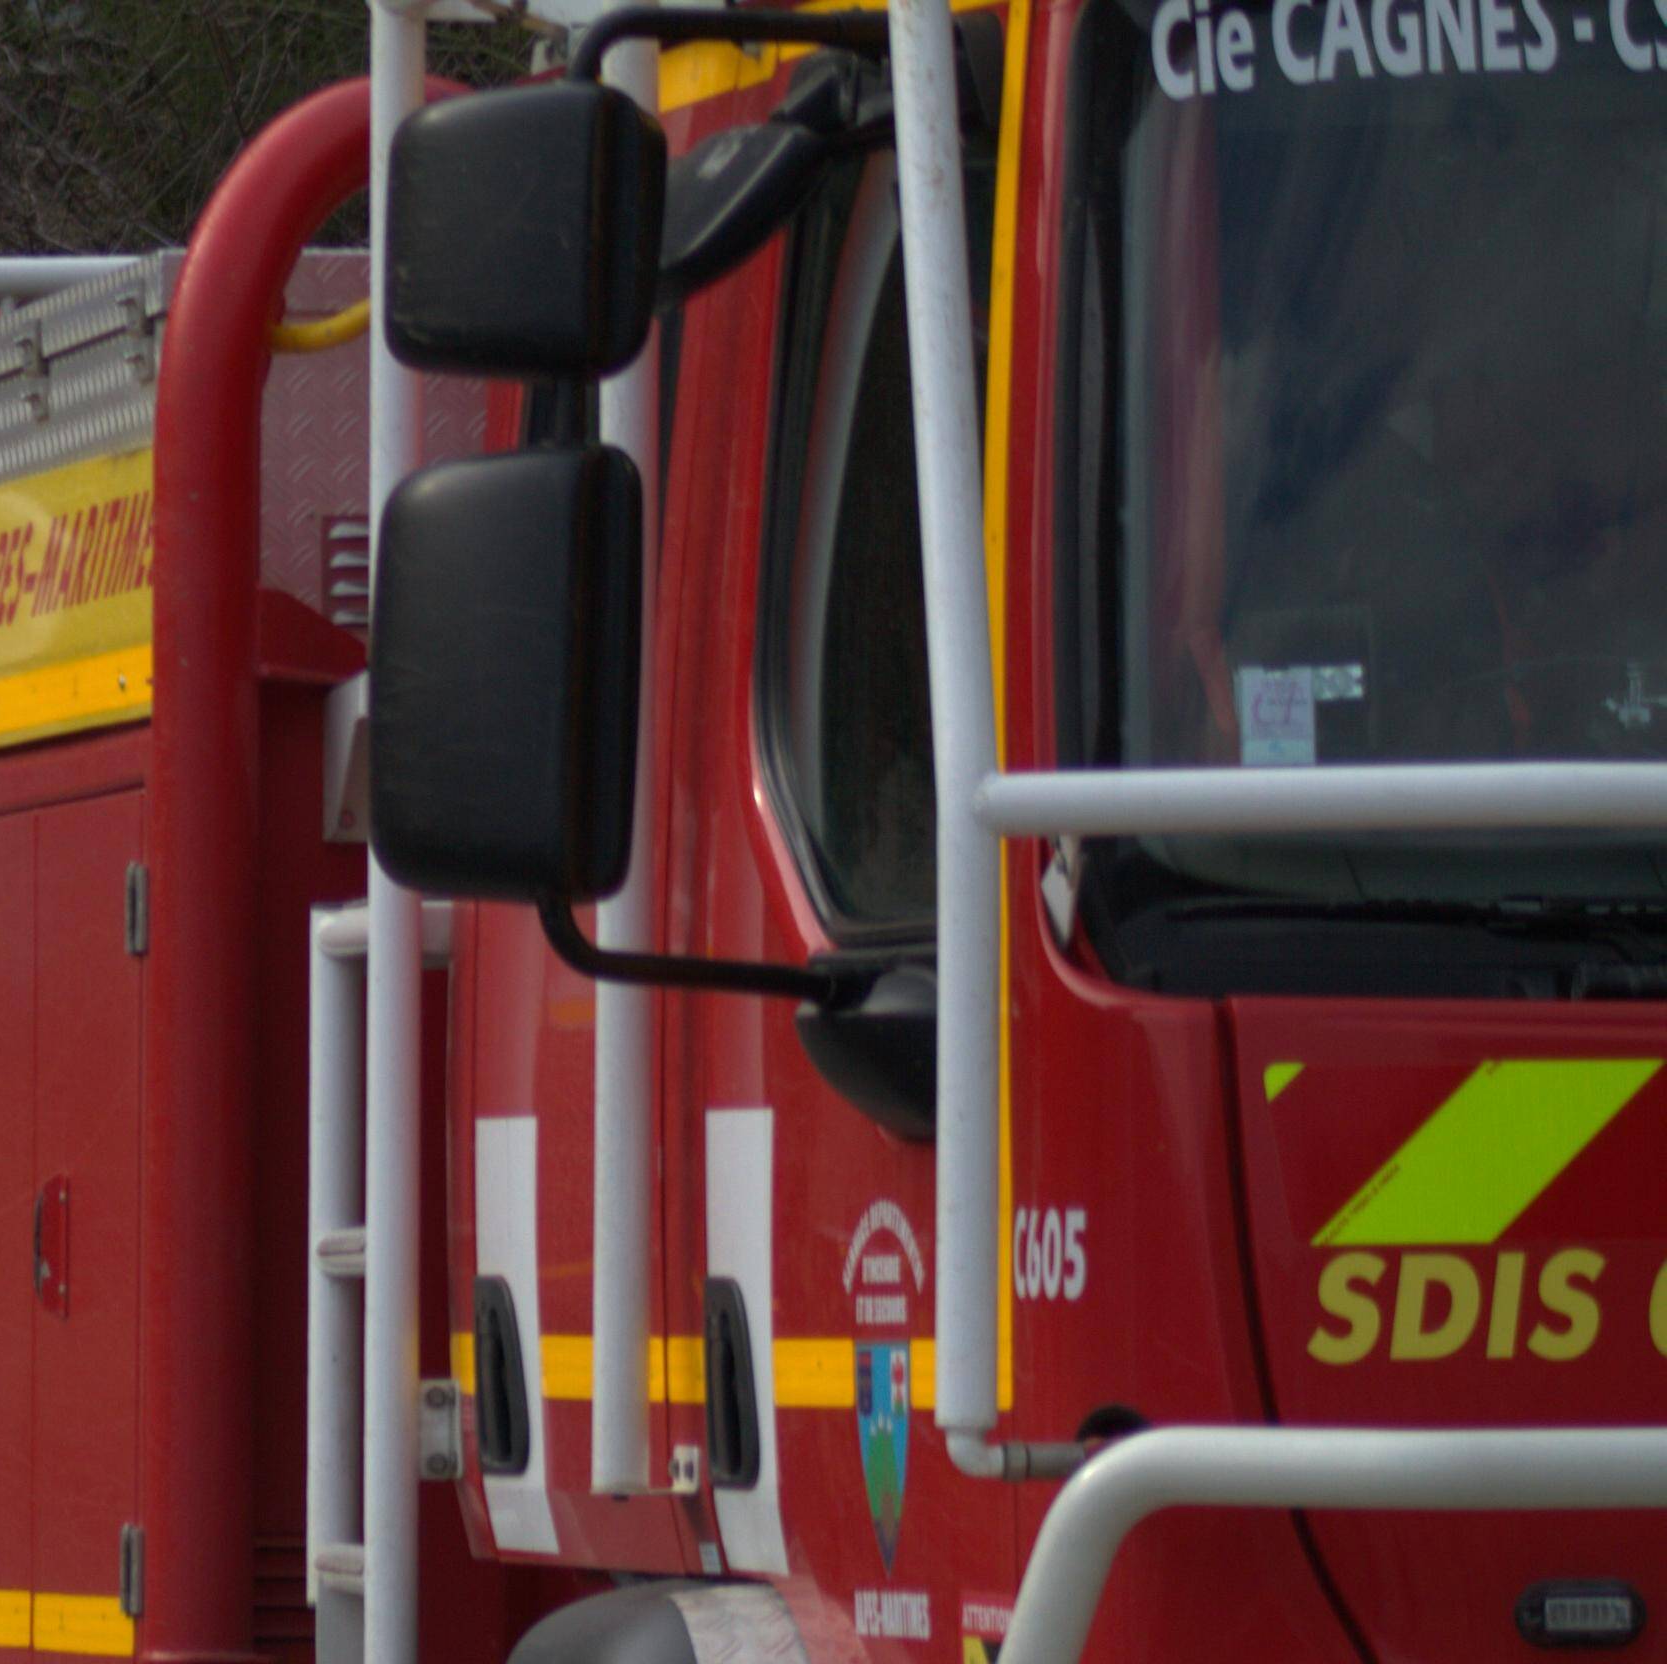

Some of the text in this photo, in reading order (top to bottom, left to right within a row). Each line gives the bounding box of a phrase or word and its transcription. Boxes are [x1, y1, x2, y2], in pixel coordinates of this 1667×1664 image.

[1151, 0, 1256, 101] Cie
[1271, 0, 1559, 86] CAGNES
[1013, 1205, 1088, 1302] C605
[1306, 1246, 1608, 1366] SDIS
